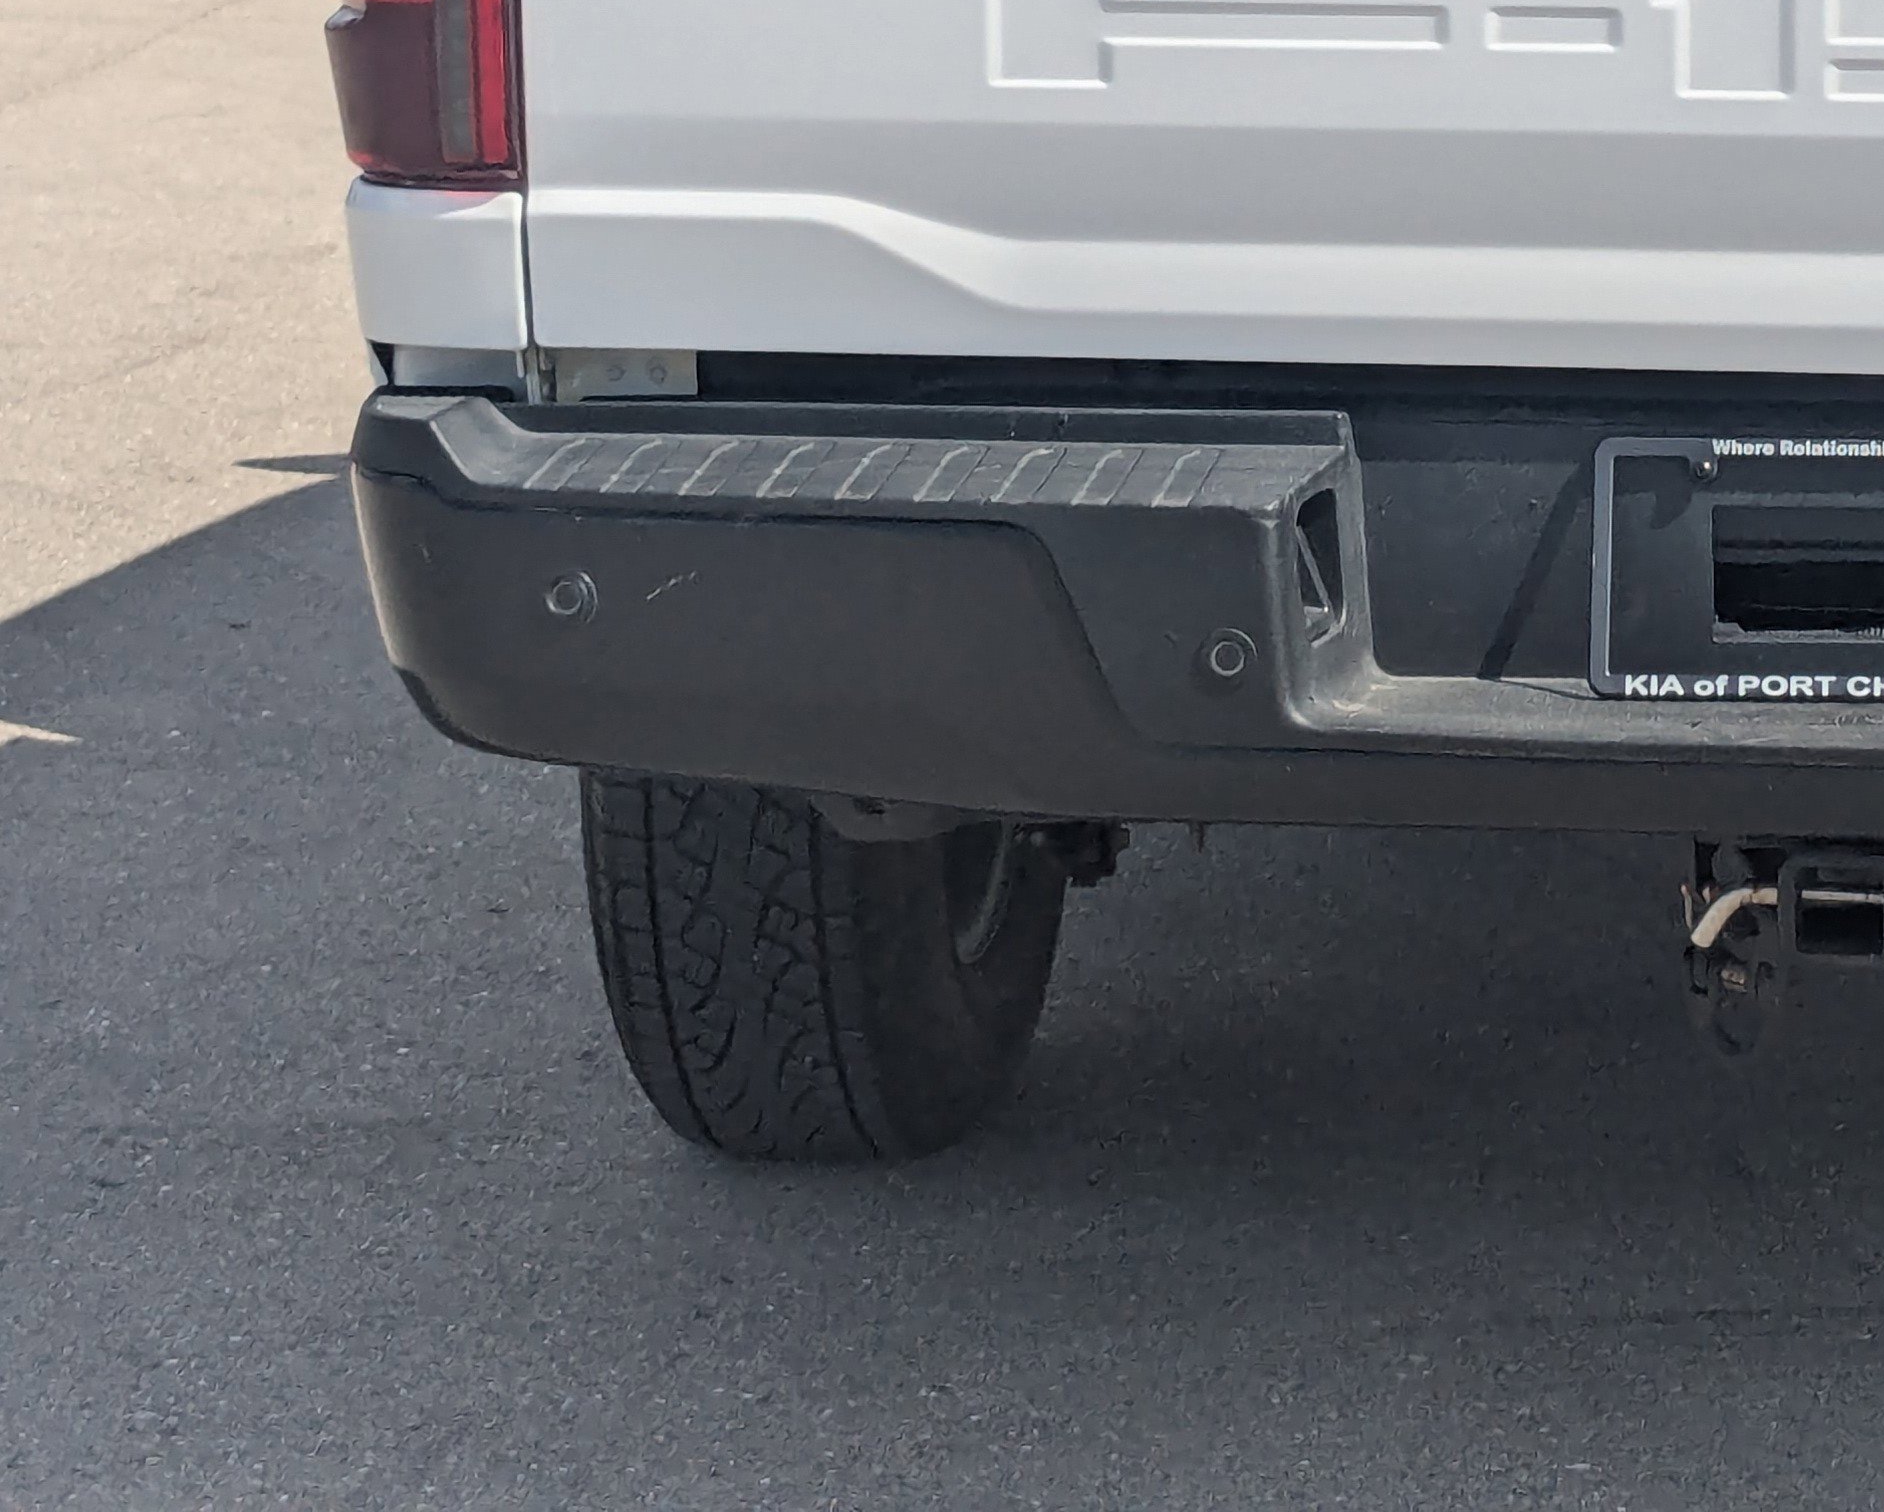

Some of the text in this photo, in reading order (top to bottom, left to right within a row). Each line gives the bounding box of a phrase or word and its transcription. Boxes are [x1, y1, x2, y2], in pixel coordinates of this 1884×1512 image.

[1712, 439, 1774, 456] Where
[1624, 675, 1685, 696] KIA
[1694, 675, 1729, 697] of
[1738, 676, 1837, 697] PORT
